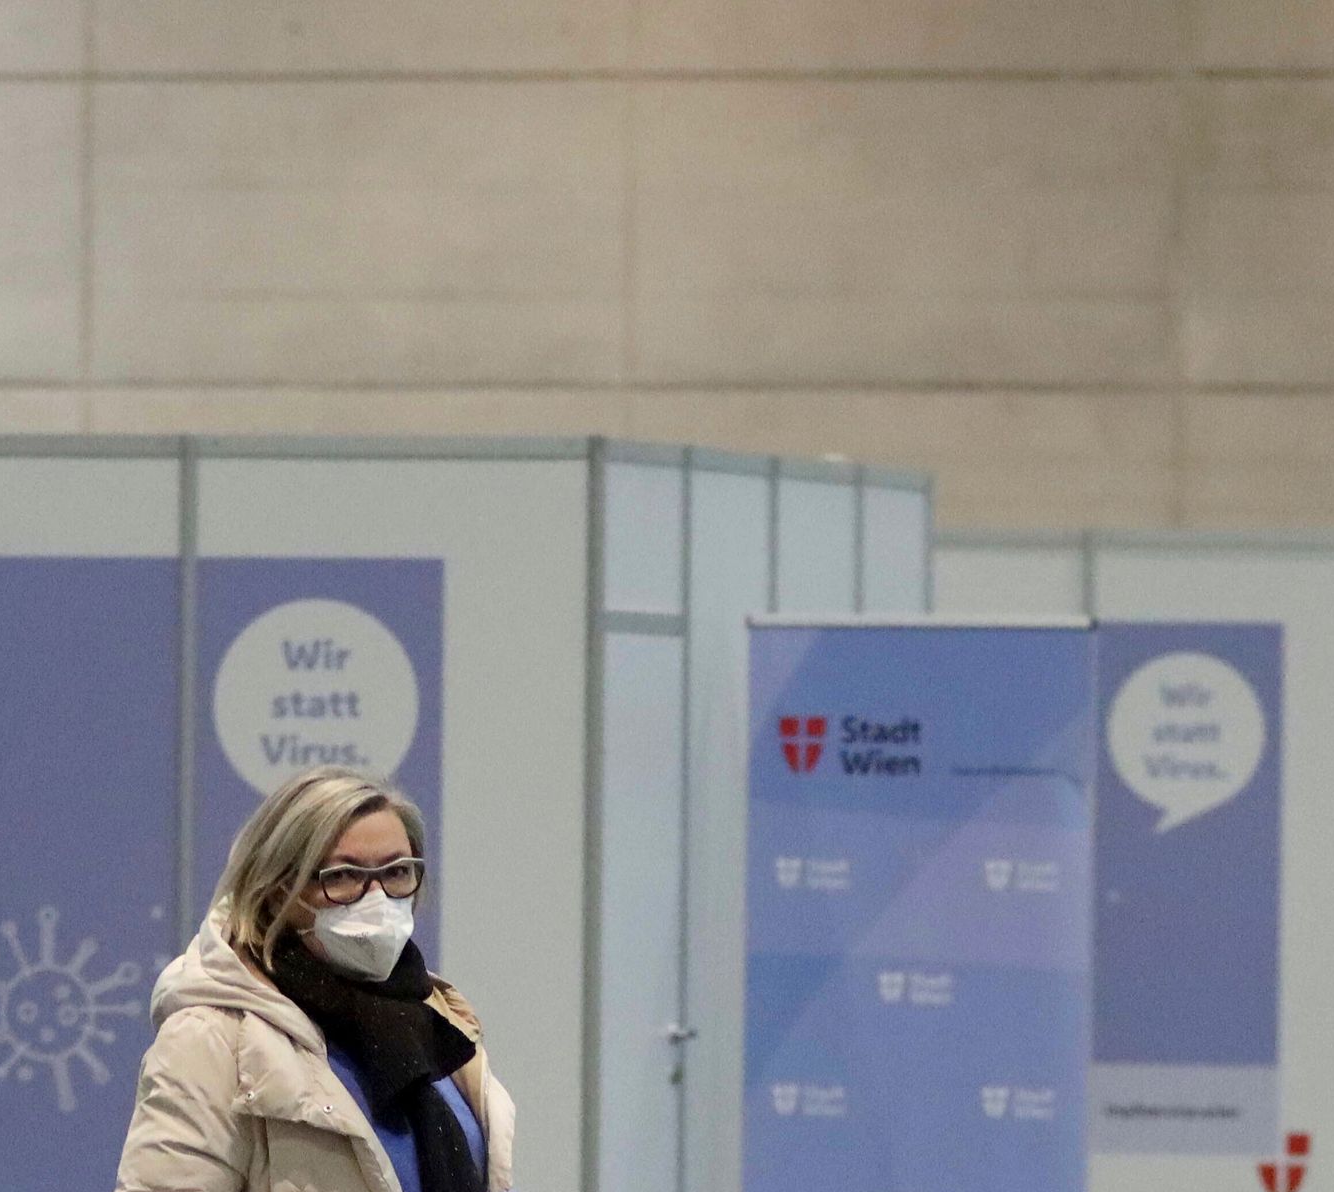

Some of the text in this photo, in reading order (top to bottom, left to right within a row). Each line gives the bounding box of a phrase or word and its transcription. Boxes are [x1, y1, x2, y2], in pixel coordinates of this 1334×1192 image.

[281, 638, 352, 671] Wir
[271, 691, 361, 719] statt
[841, 715, 922, 744] Stadt
[260, 734, 369, 766] Virus.
[840, 750, 921, 776] Wien
